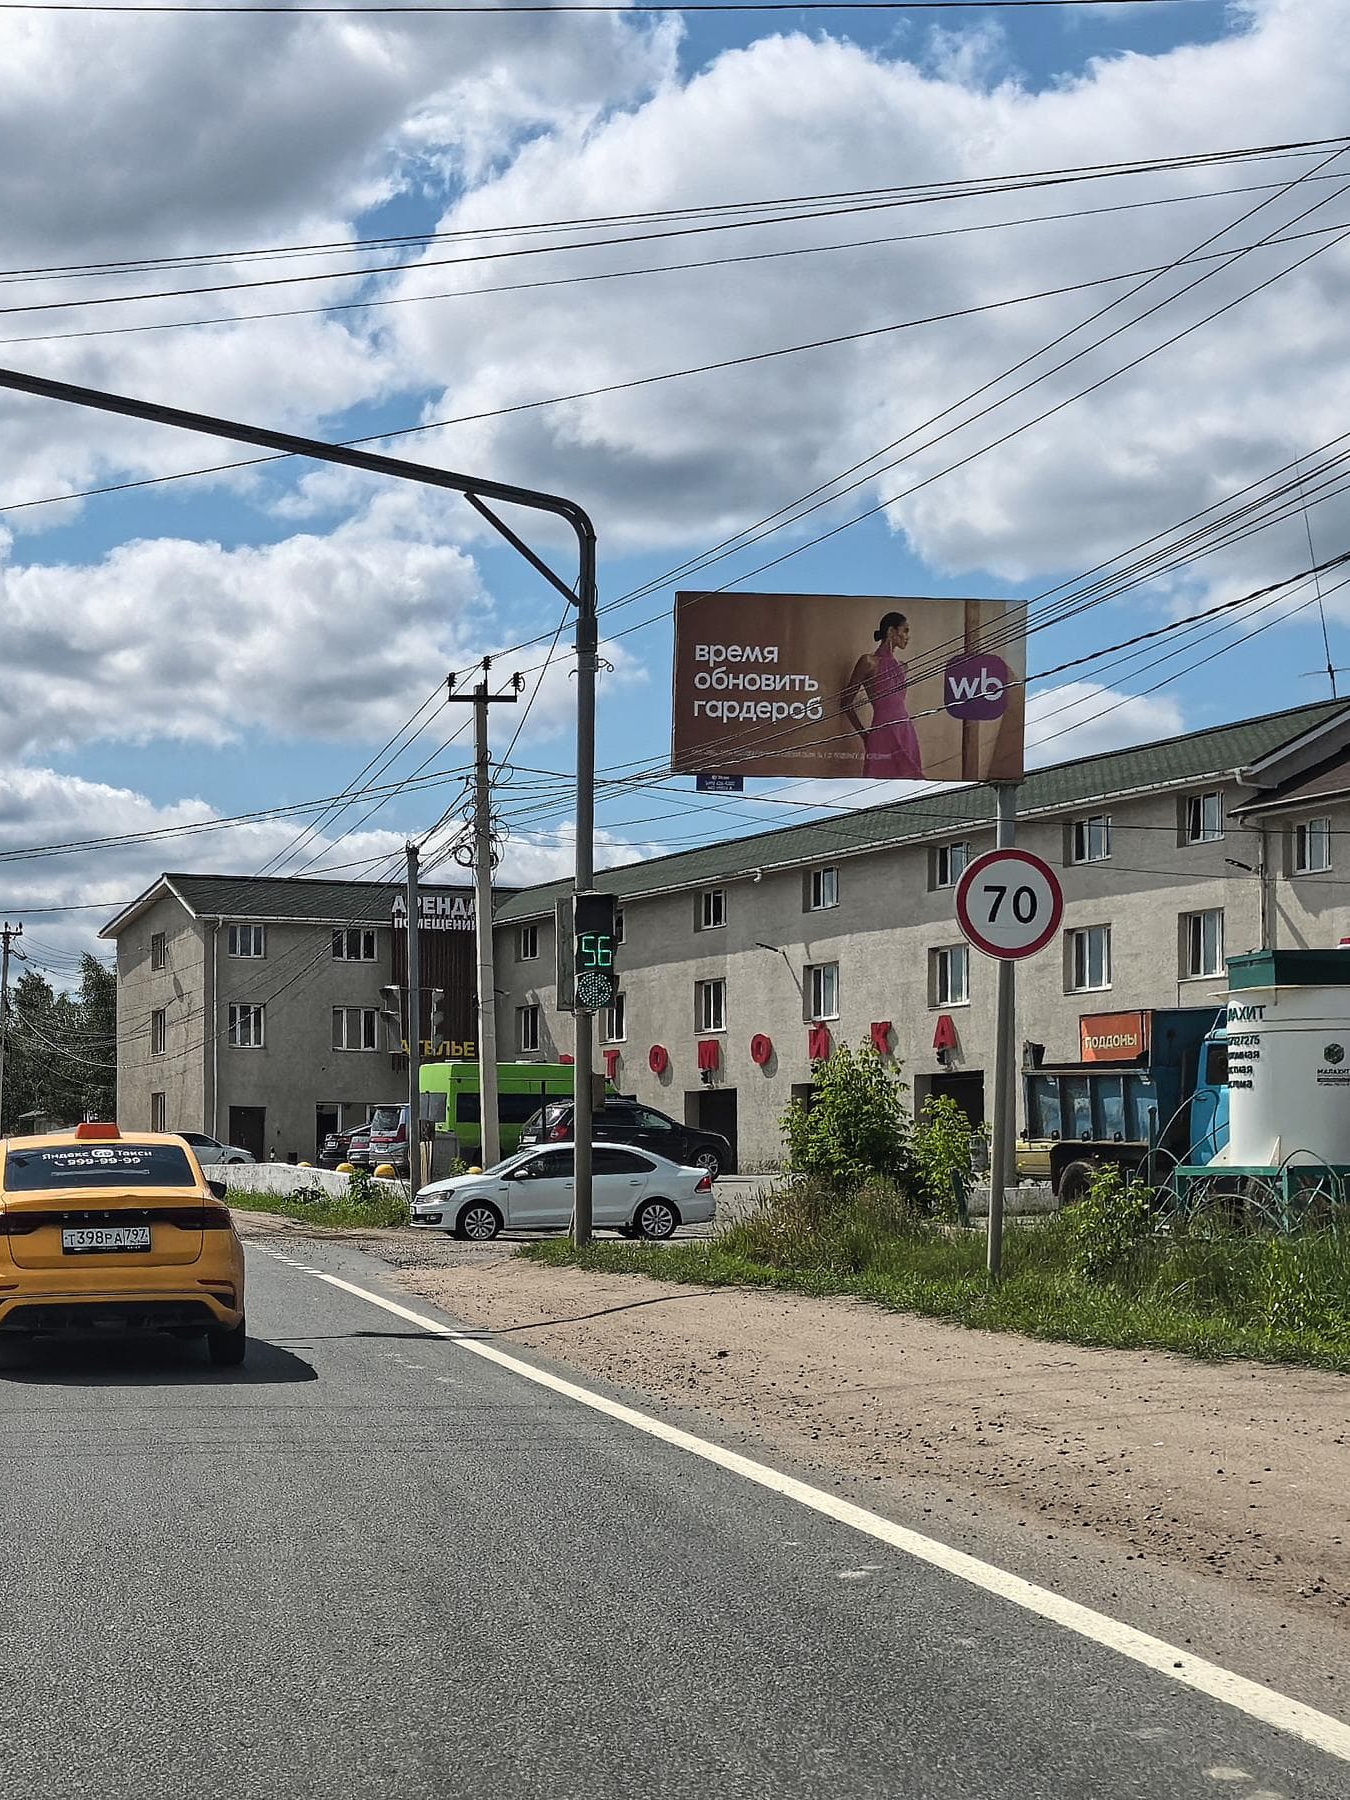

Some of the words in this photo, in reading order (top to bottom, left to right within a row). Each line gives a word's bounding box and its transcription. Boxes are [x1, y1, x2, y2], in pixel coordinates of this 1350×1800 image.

[695, 645, 778, 667] время
[694, 667, 819, 691] обновить
[949, 668, 1003, 701] wb
[693, 697, 823, 723] гардероб
[983, 886, 1037, 924] 70
[582, 936, 612, 966] 56
[1084, 1034, 1138, 1049] ПОДДОНЫ
[42, 1151, 90, 1160] Яндекс
[115, 1149, 152, 1157] Такси
